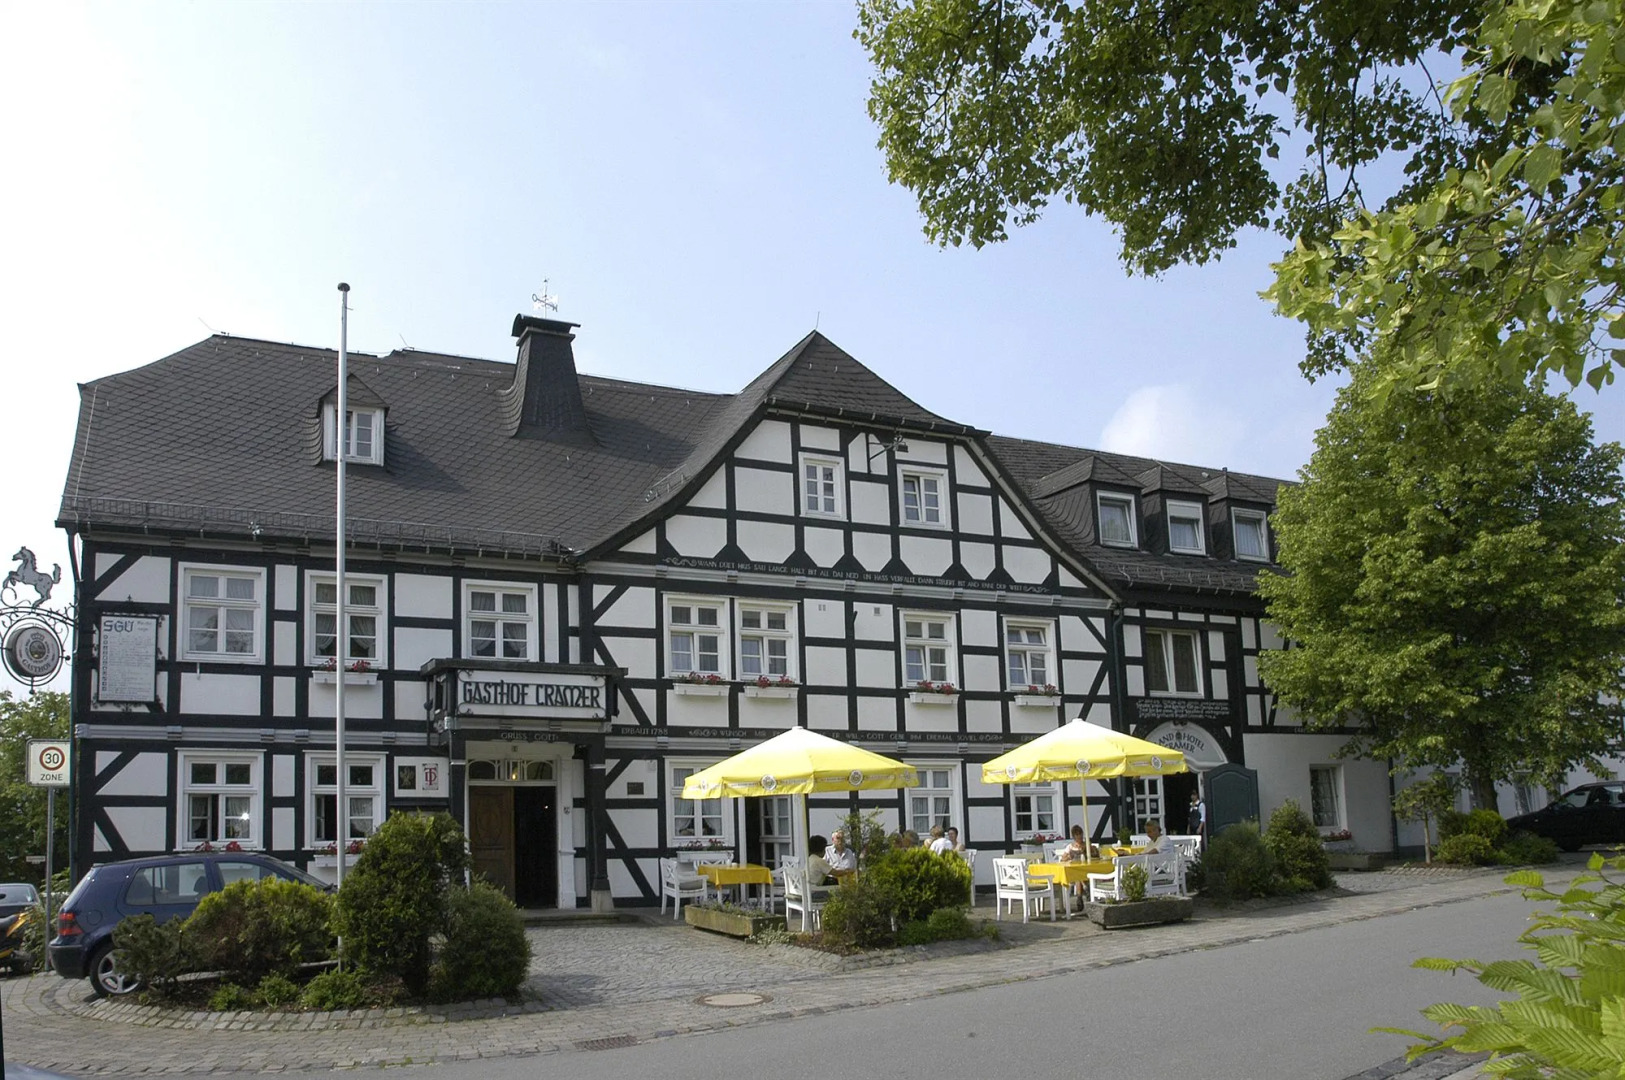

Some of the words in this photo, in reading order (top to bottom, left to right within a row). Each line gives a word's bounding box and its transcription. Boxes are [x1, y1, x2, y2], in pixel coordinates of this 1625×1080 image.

[463, 680, 529, 705] GASTHOF
[535, 684, 600, 708] CRAMER
[621, 727, 649, 735] ERBAUT
[1153, 732, 1175, 746] AND
[1183, 732, 1205, 751] HOTEL
[1163, 740, 1196, 753] RAMER
[45, 753, 60, 765] 30
[40, 773, 63, 781] ZONE
